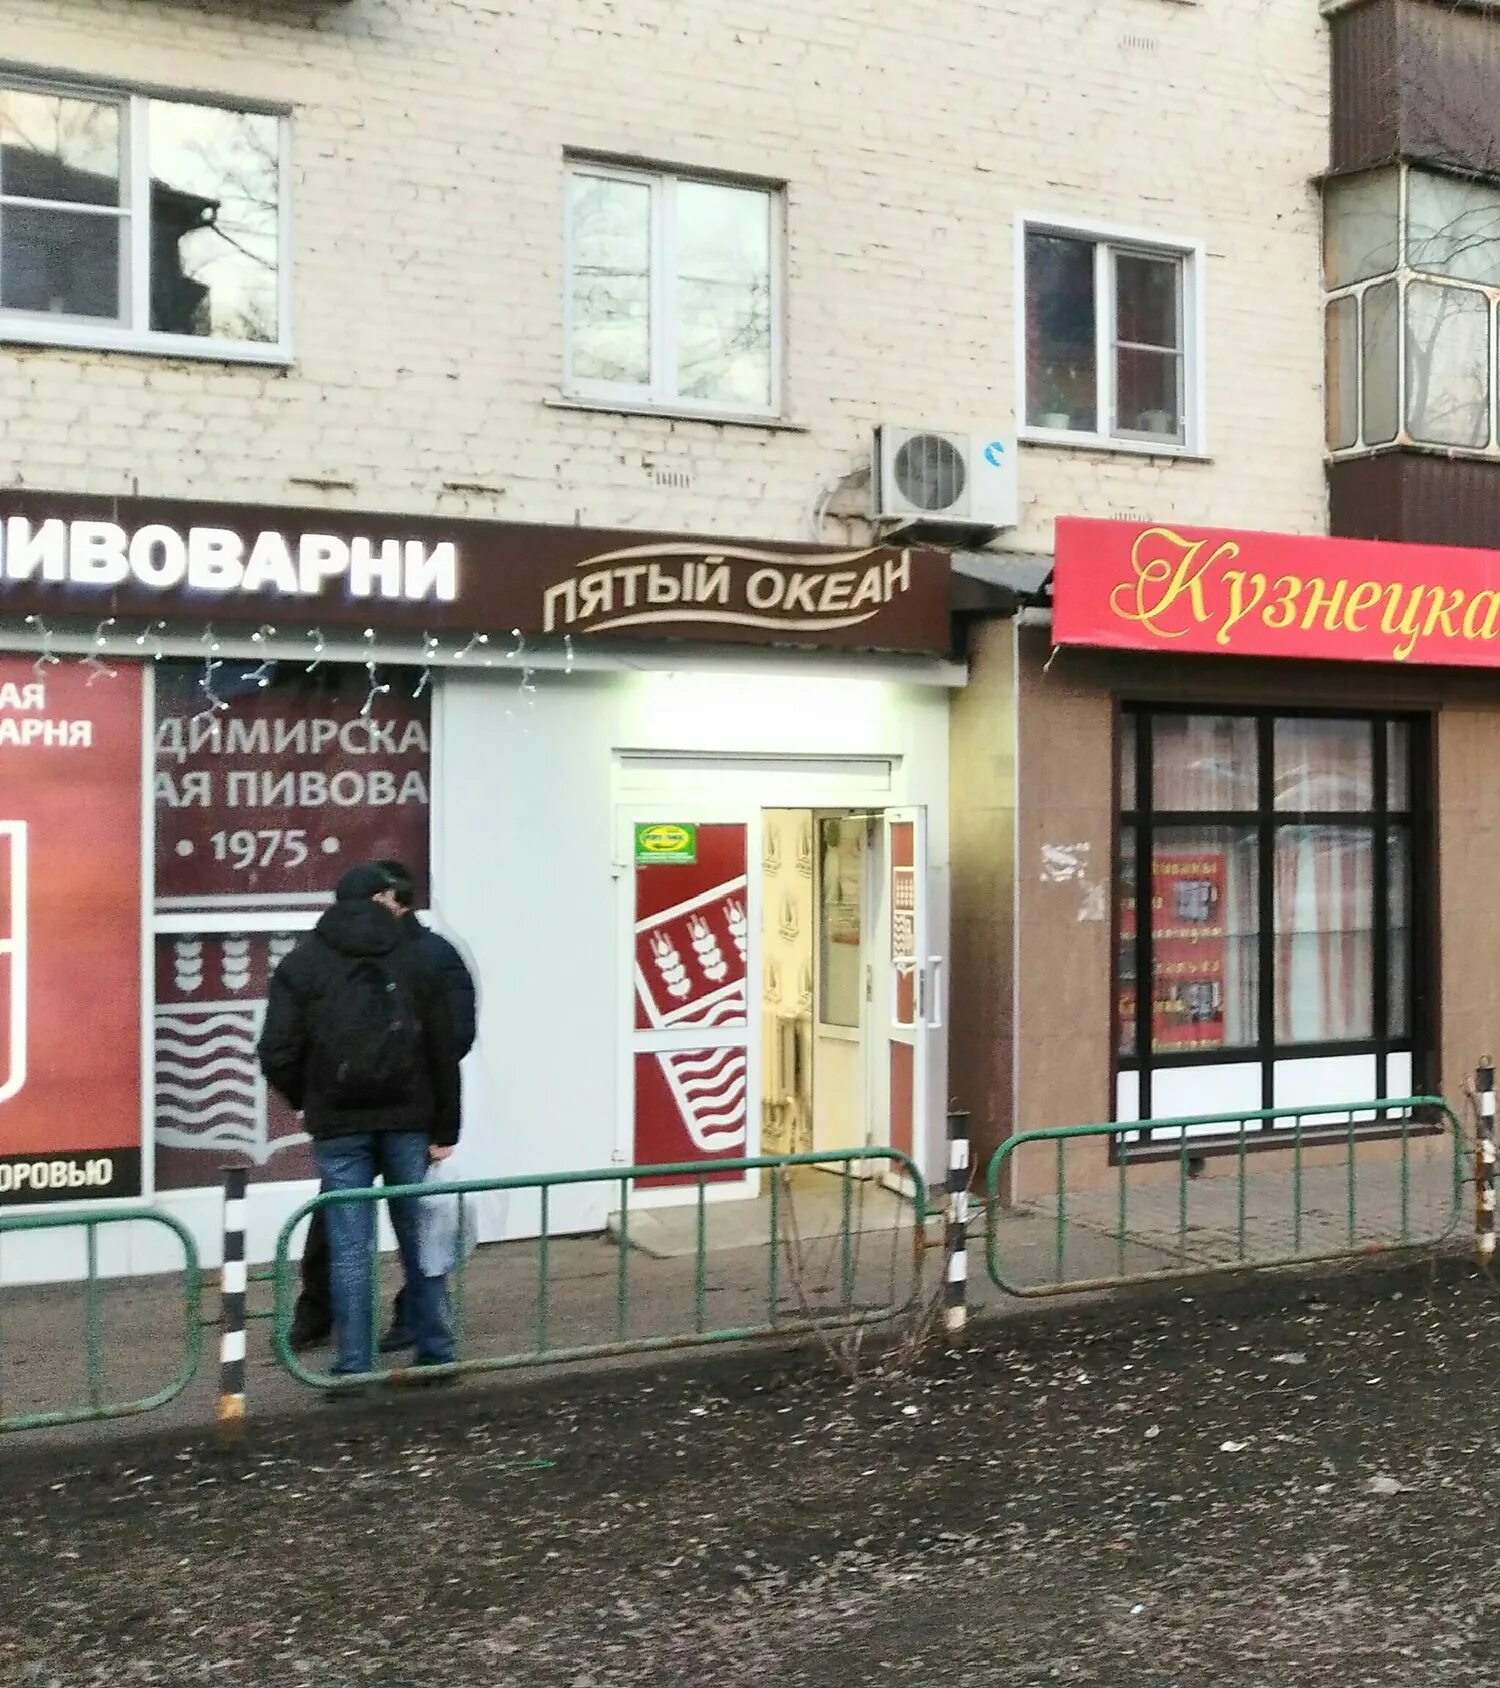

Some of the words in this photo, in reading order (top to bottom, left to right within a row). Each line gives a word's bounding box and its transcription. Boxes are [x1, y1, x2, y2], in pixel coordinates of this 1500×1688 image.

[0, 516, 456, 600] ИВОВАРНИ
[543, 555, 731, 632] ПЯТЫЙ
[746, 549, 911, 612] ОКЕАН
[0, 682, 45, 710] АЯ
[0, 718, 92, 747] АРНЯ
[154, 717, 429, 764] ДИМИРСКА
[154, 770, 212, 807] АЯ
[226, 770, 429, 807] ПИВОВА
[210, 828, 308, 870] 1975
